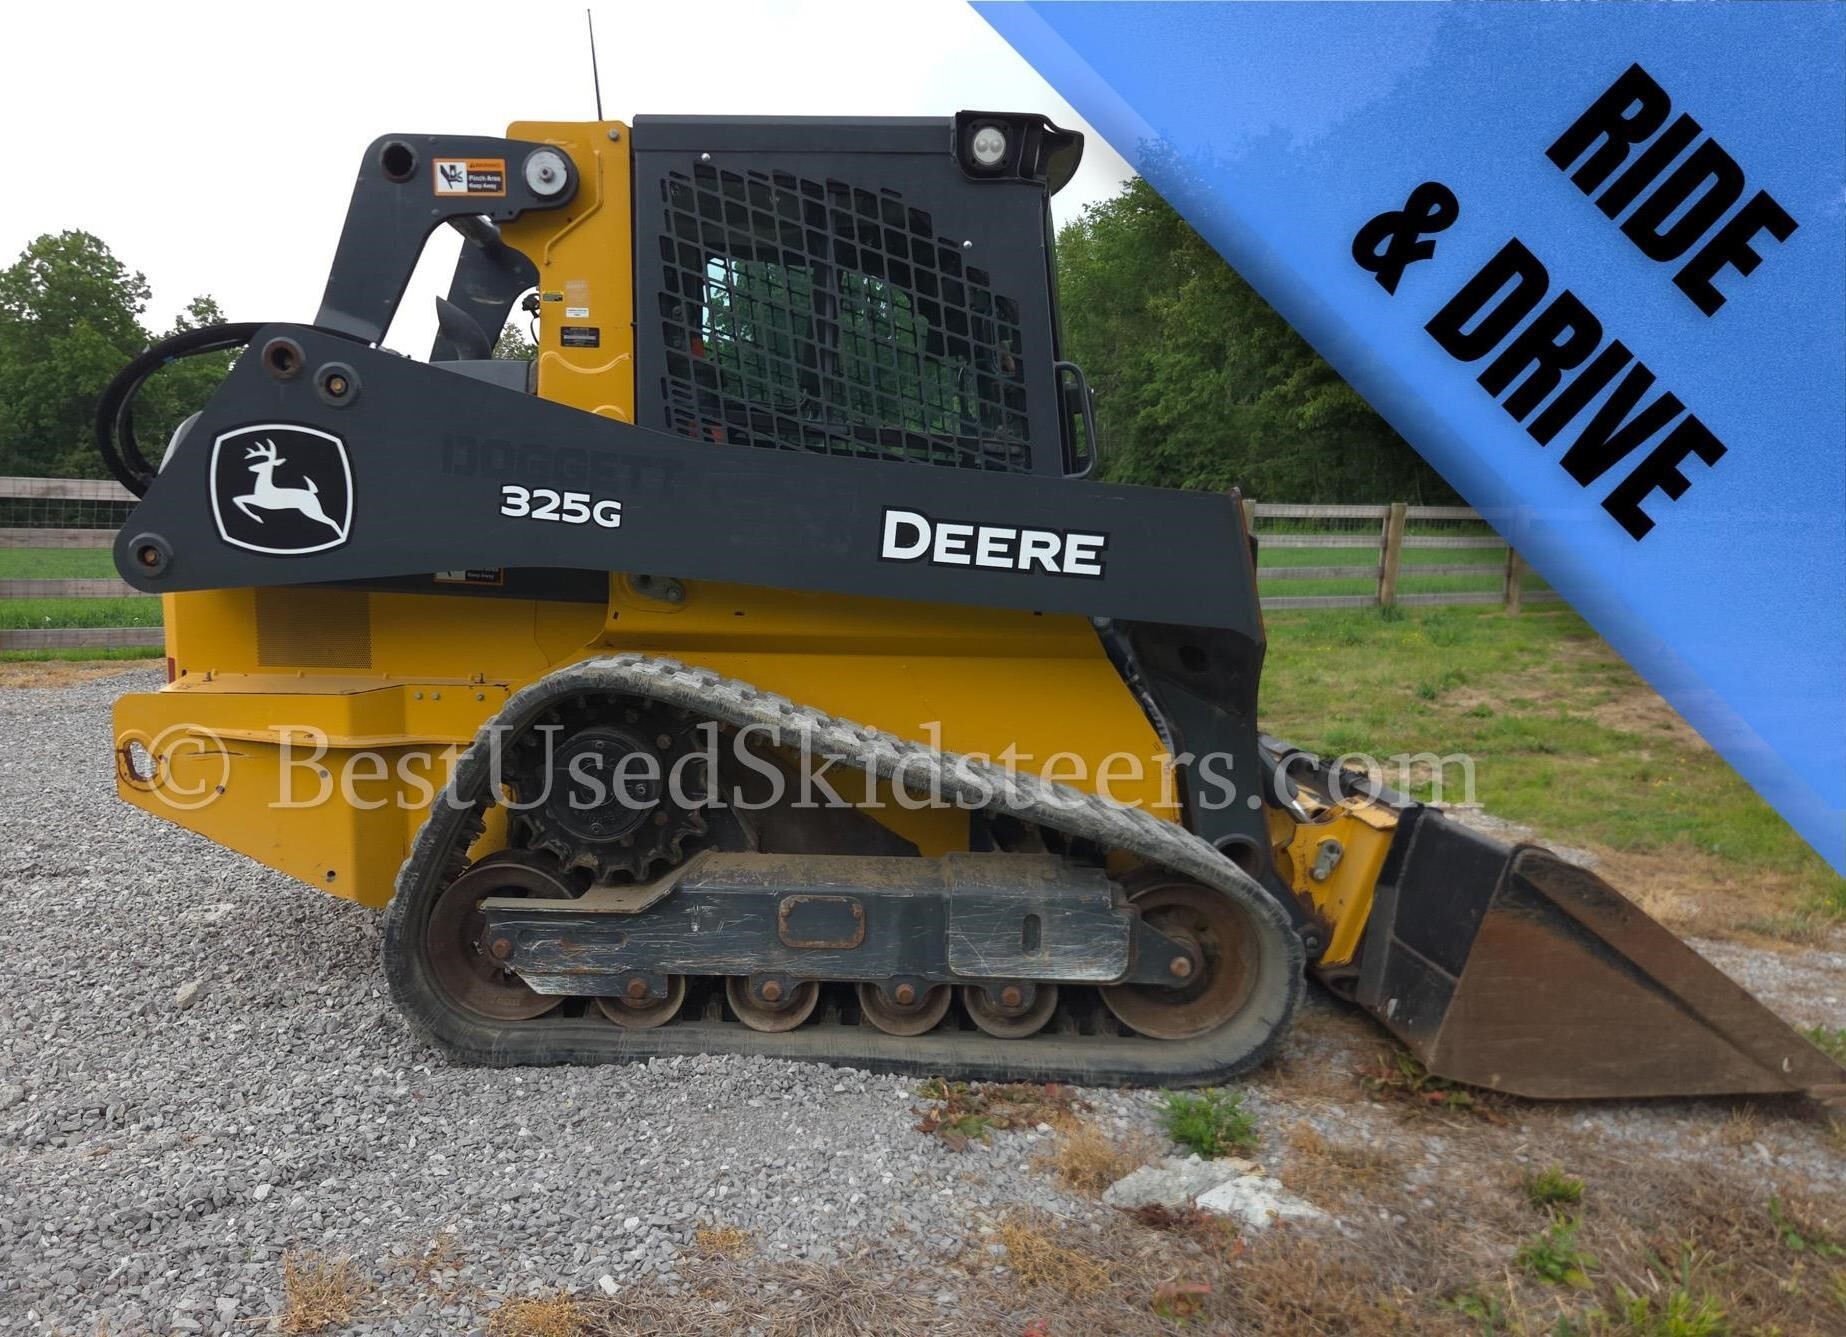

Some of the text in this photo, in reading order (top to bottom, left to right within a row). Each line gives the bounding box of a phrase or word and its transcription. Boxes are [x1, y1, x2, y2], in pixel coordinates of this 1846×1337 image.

[442, 434, 686, 495] DOGGETT
[501, 485, 622, 528] 325G
[882, 510, 1105, 575] DEERE
